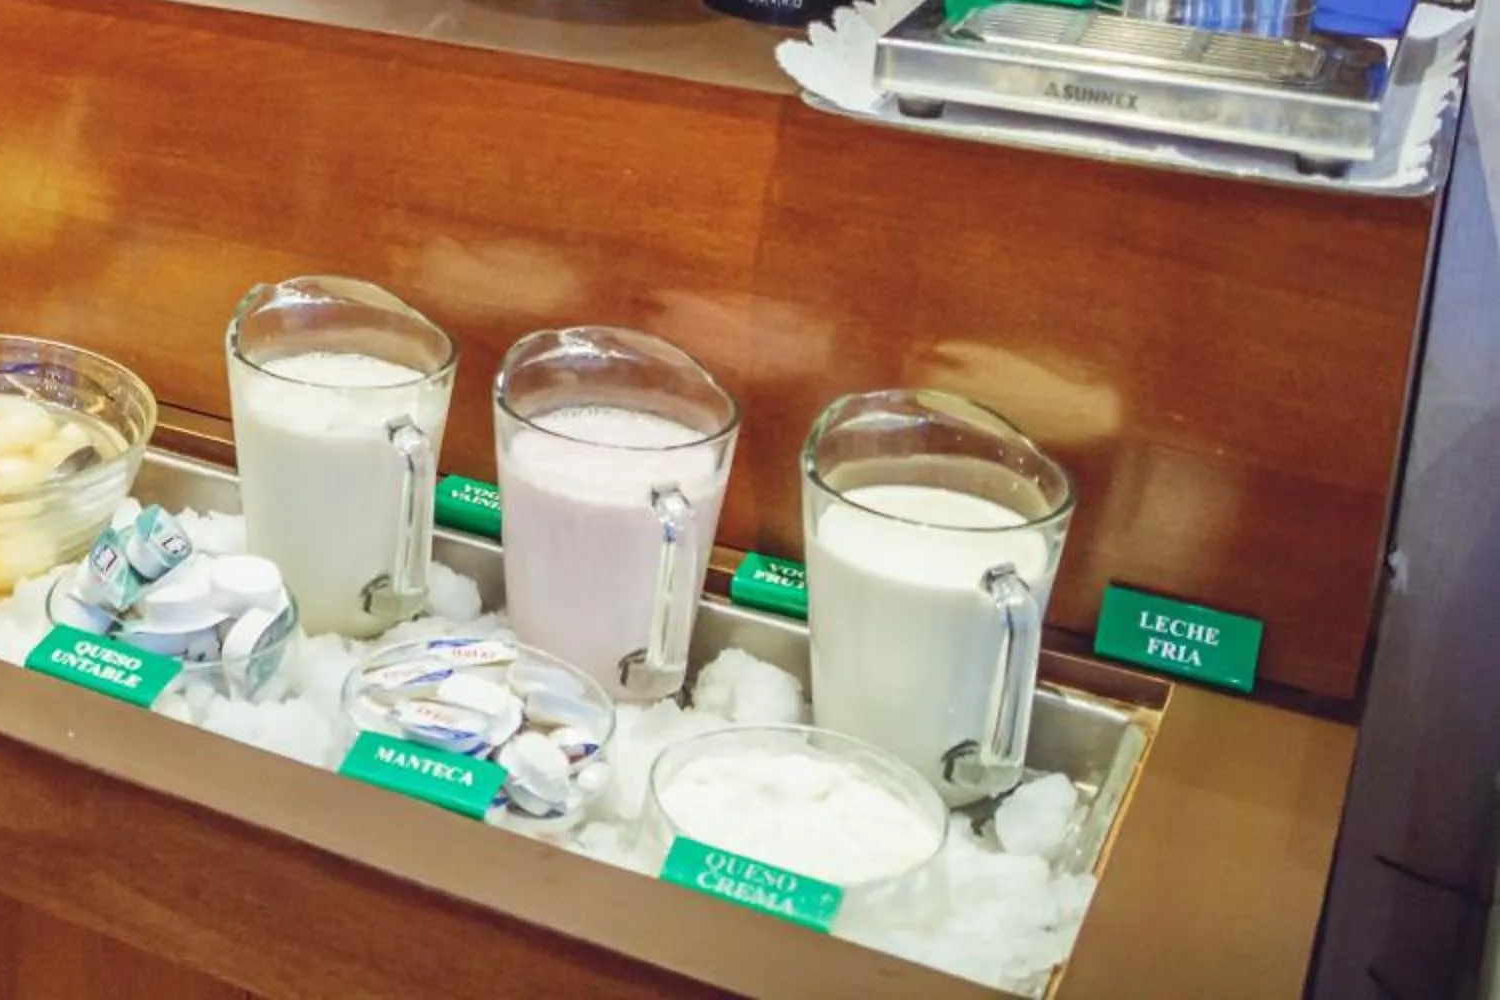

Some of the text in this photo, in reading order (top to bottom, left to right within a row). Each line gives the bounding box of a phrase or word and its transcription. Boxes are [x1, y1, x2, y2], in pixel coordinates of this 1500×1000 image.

[1139, 611, 1221, 646] LECHE
[51, 649, 143, 689] UNTABLE
[74, 641, 142, 671] QUESO
[1147, 638, 1202, 666] FRIA
[374, 745, 474, 787] MANTECA
[704, 852, 797, 892] QUESO
[696, 871, 796, 916] CREMA
